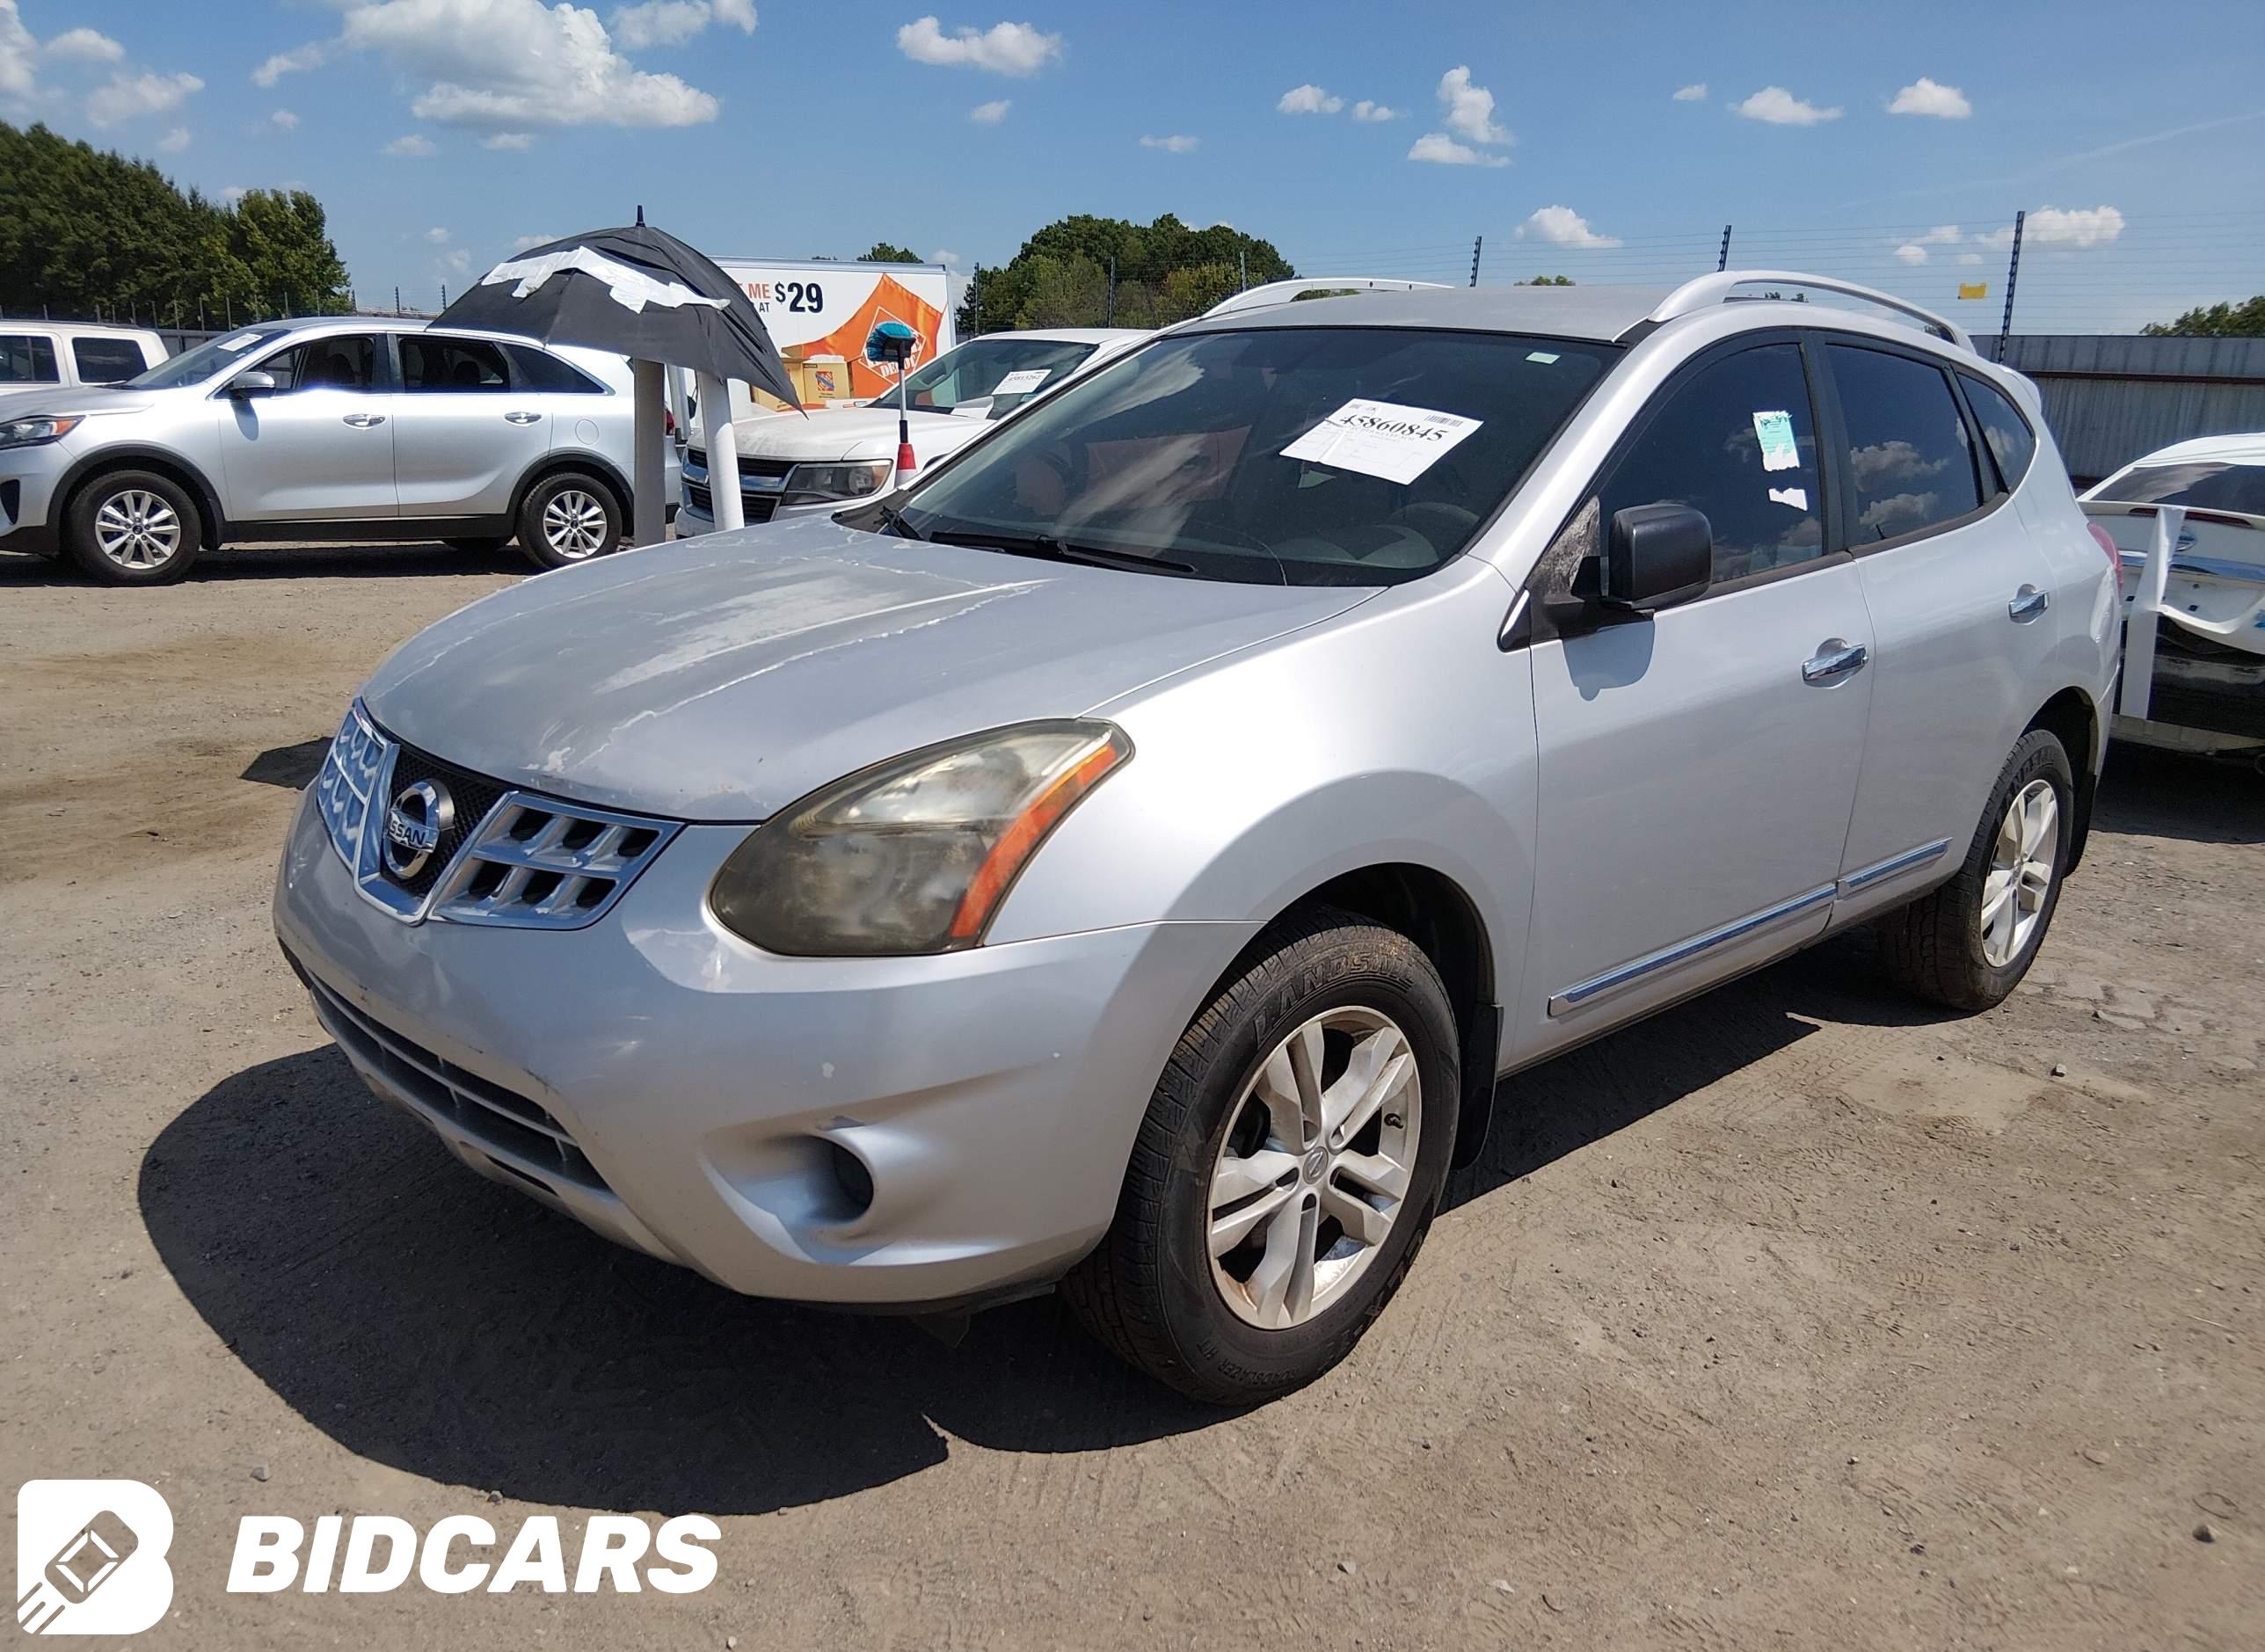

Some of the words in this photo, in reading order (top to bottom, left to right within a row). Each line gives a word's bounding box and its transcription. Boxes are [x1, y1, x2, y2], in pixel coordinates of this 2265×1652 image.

[748, 283, 770, 299] ME
[775, 281, 823, 313] $29
[759, 302, 770, 313] AT
[1340, 414, 1449, 441] 45860845
[387, 819, 426, 846] SSAN
